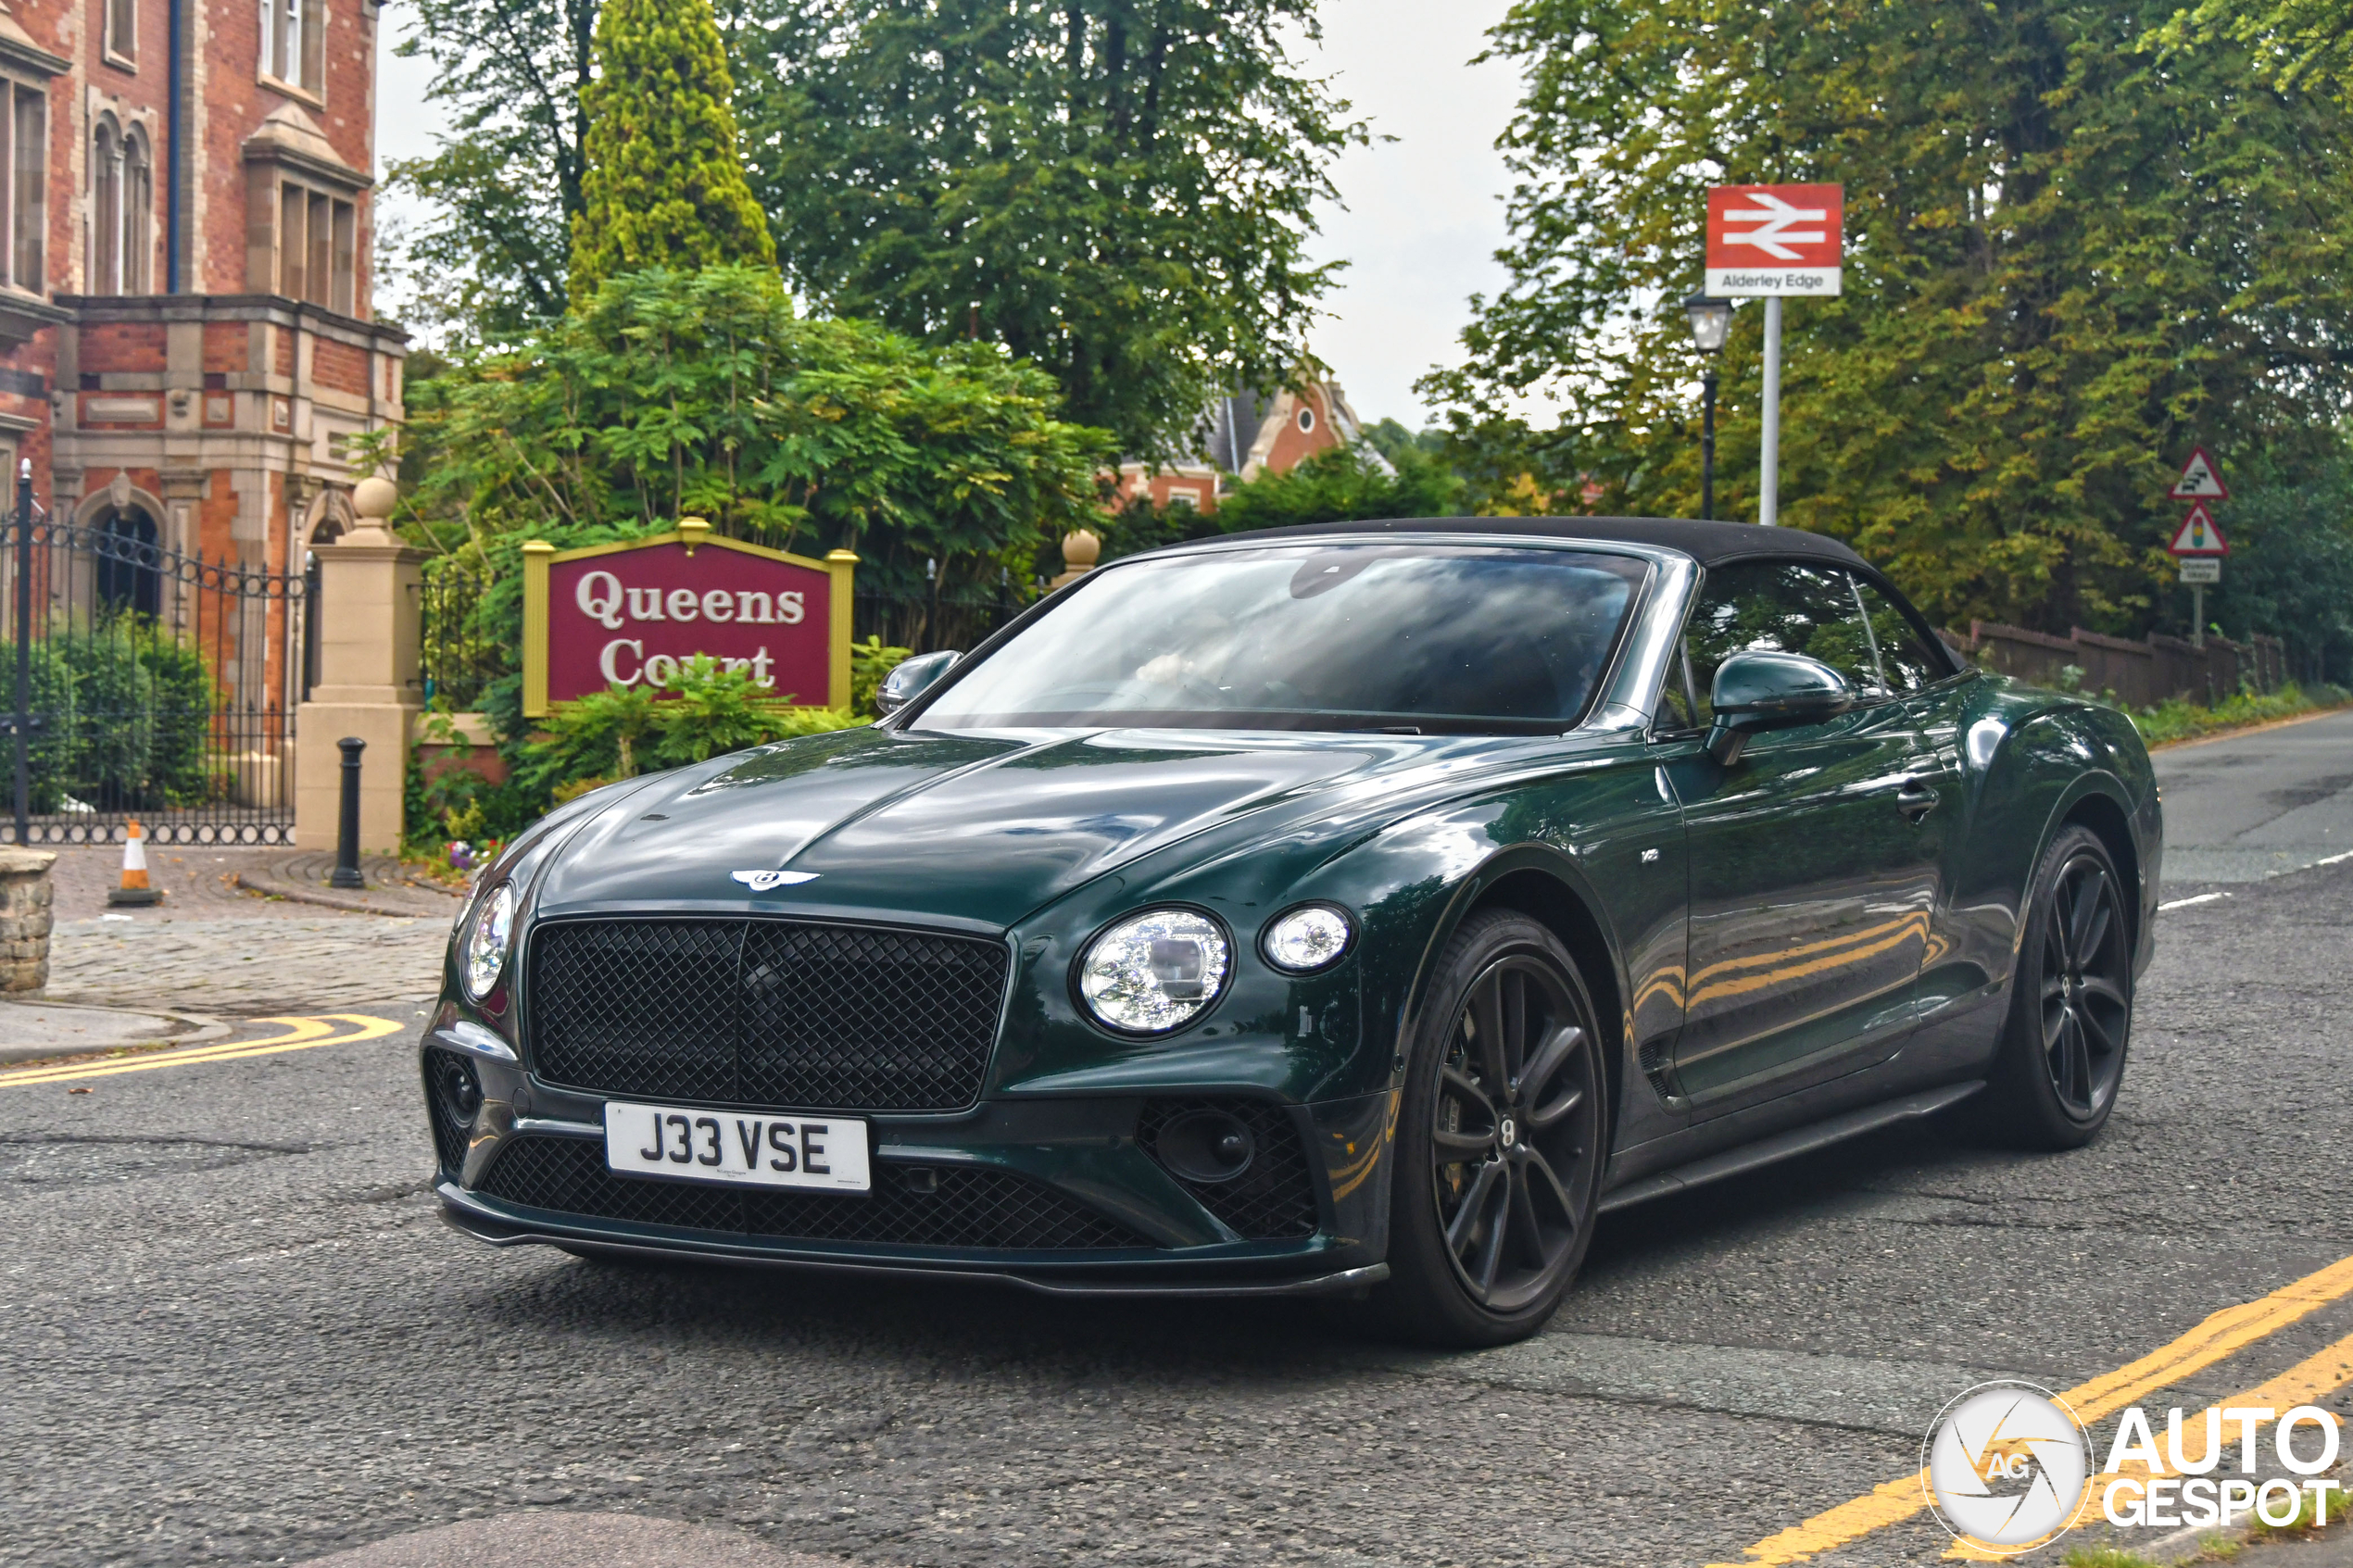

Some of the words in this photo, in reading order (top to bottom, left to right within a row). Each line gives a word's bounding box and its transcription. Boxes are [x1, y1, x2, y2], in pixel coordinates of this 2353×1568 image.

[1722, 274, 1781, 289] Alderley
[1786, 274, 1824, 289] Edge
[575, 571, 805, 630] Queens
[640, 1112, 724, 1167] J33
[736, 1120, 831, 1174] VSE
